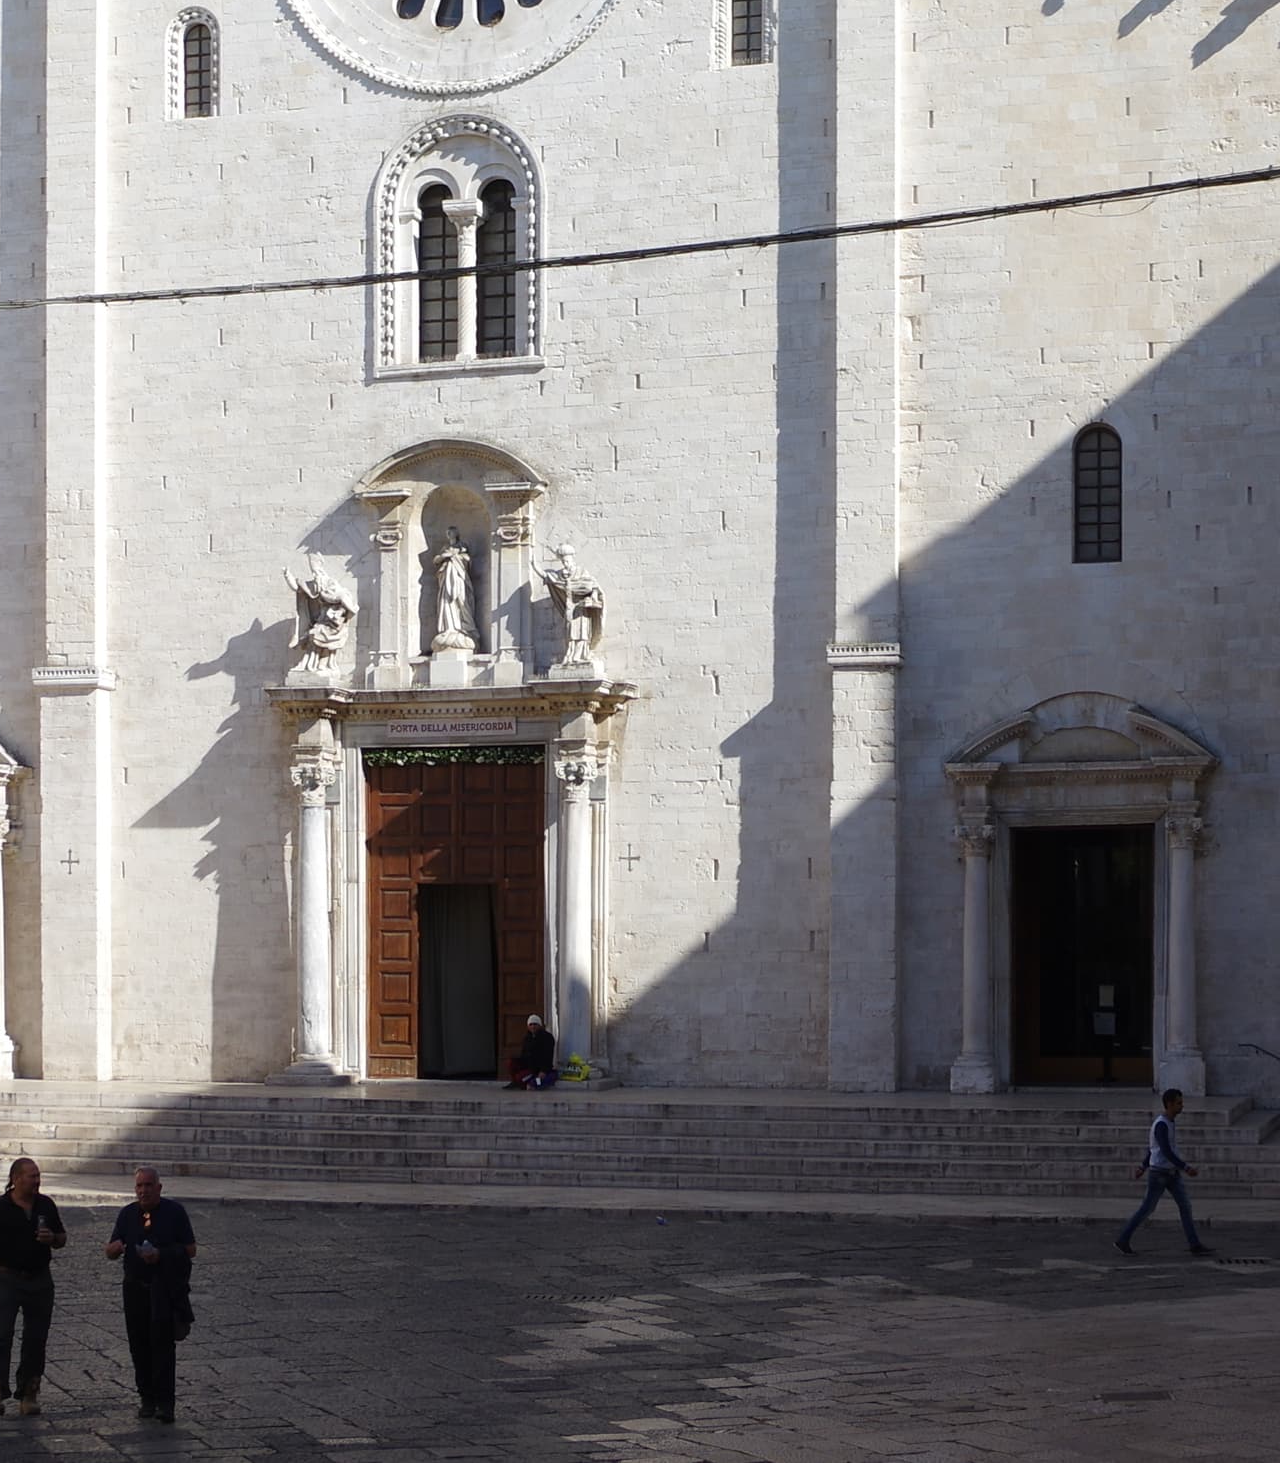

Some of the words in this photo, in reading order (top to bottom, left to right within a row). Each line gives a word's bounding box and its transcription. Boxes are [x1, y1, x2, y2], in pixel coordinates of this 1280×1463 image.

[390, 724, 418, 733] PORTA
[421, 724, 448, 732] DELLA
[450, 722, 513, 732] MISERICORDIA
